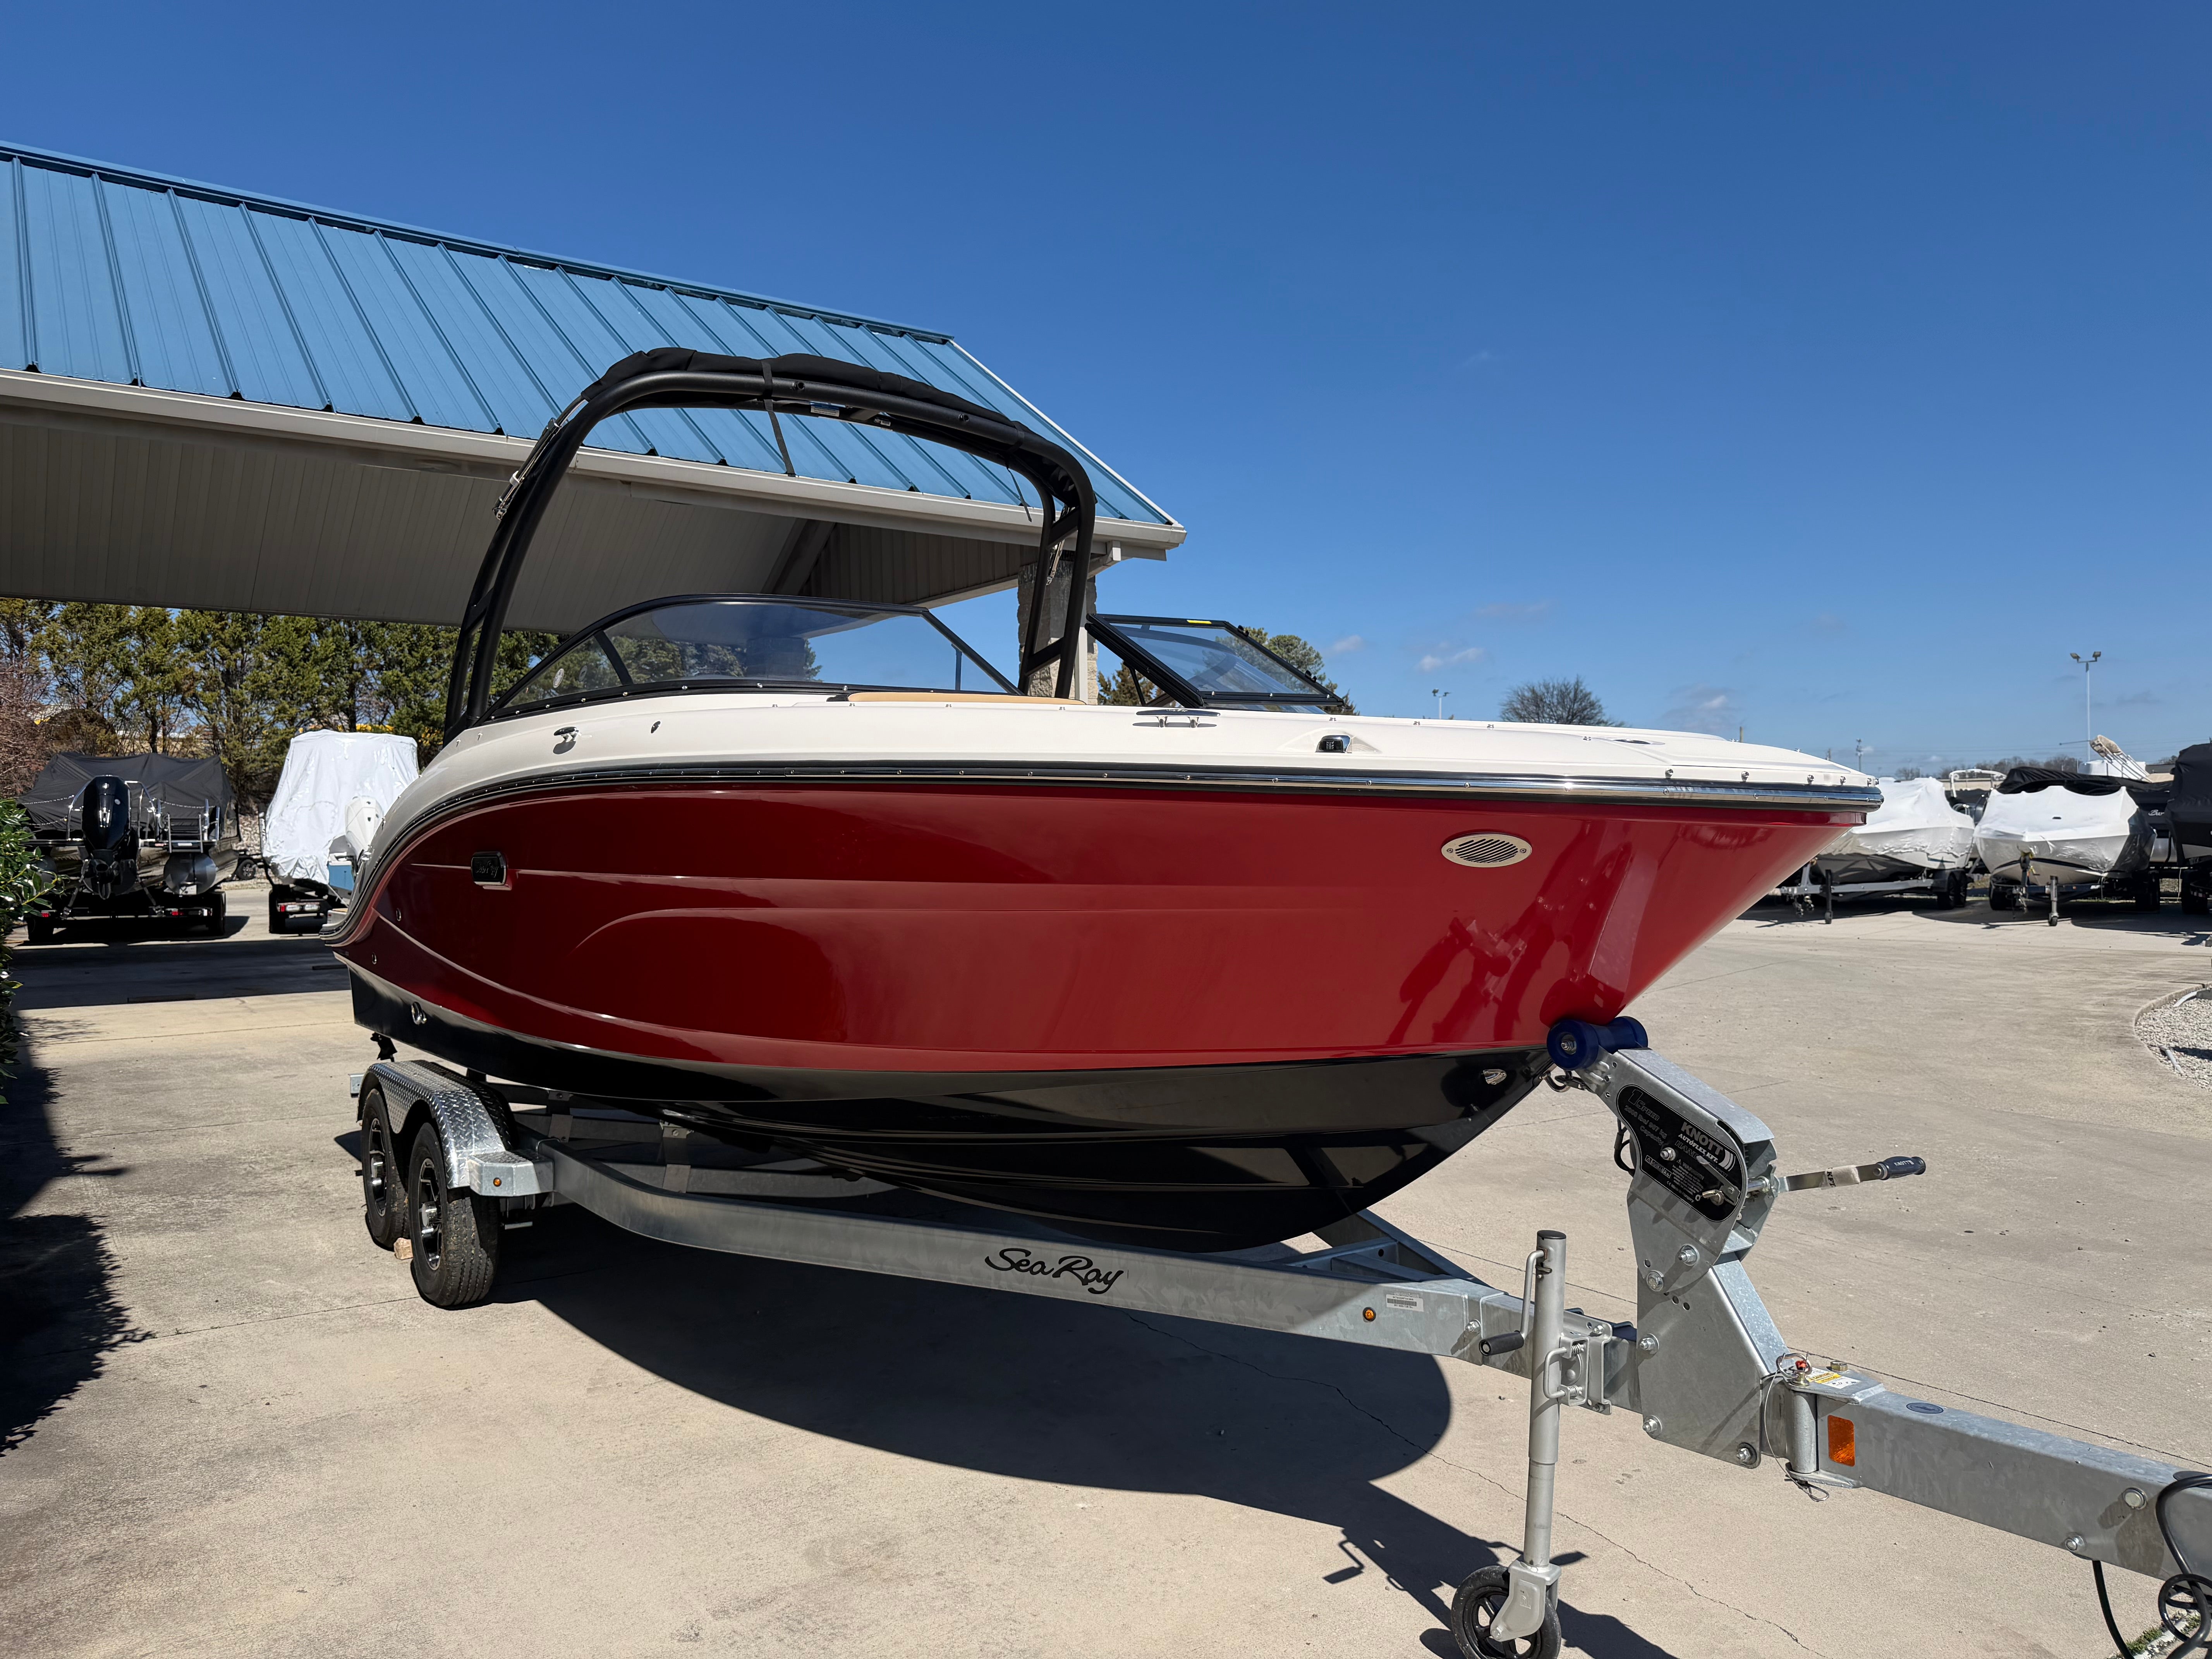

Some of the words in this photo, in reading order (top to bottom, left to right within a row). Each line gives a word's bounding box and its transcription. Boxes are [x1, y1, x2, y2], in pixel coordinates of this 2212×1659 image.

[1678, 1133, 1707, 1155] AUTÓFLEX
[1706, 1152, 1718, 1163] KFT.
[1681, 1121, 1724, 1156] KNOTT
[984, 1248, 1054, 1276] Sea
[1052, 1255, 1124, 1295] Ray
